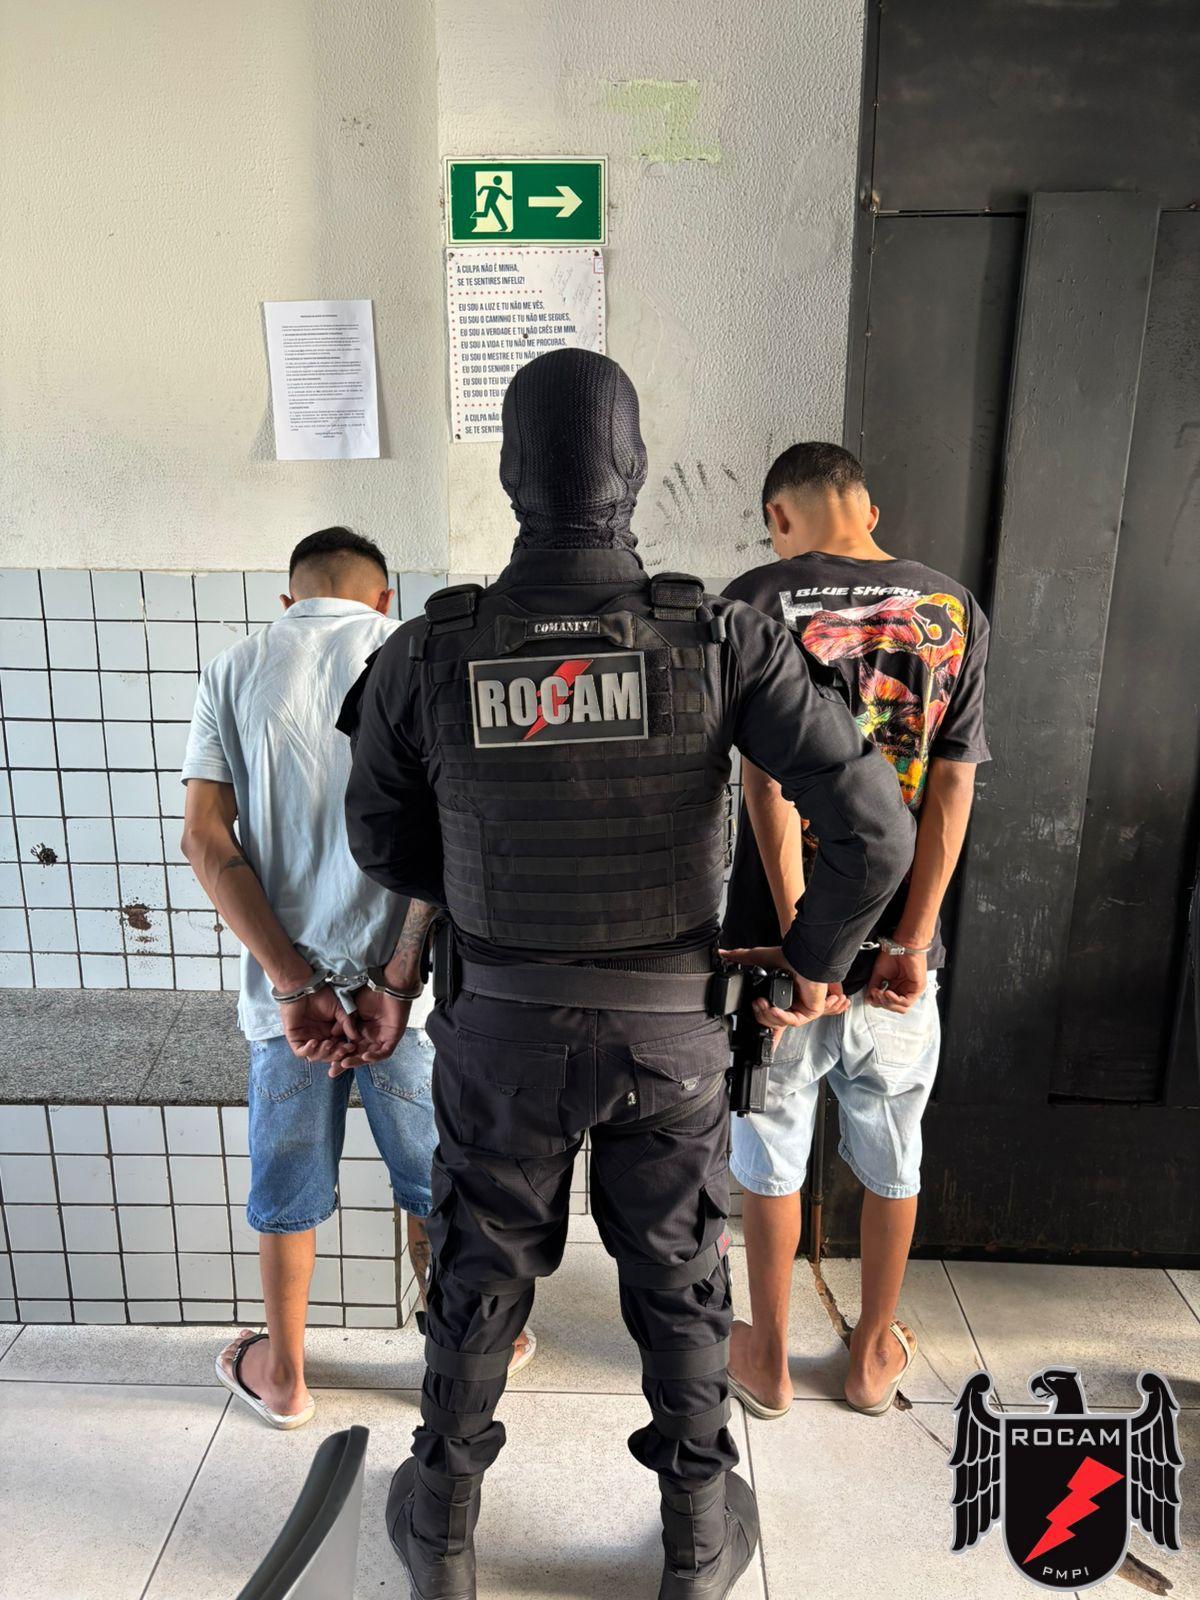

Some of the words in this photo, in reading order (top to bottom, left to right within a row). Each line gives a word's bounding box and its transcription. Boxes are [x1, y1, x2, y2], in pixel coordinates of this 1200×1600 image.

[462, 265, 480, 273] CULPA
[481, 262, 493, 272] NÃO
[457, 278, 464, 286] SE
[466, 278, 473, 286] TE
[474, 277, 501, 285] SENTIRES
[459, 303, 466, 311] EU
[467, 303, 479, 311] SOU
[485, 302, 496, 310] LUZ
[501, 302, 509, 310] TU
[510, 300, 522, 310] NÃO
[523, 301, 531, 309] ME
[459, 316, 467, 324] EU
[468, 315, 480, 324] SOU
[485, 314, 511, 323] CAMINHO
[517, 314, 525, 322] TU
[526, 312, 538, 322] NÃO
[539, 313, 547, 321] ME
[460, 328, 468, 336] EU
[469, 328, 480, 336] SOU
[486, 327, 511, 335] VERDADE
[517, 326, 525, 334] TU
[526, 325, 538, 334] NÃO
[539, 324, 553, 334] CRÊS
[554, 325, 562, 334] EM
[461, 341, 468, 349] EU
[469, 341, 481, 349] SOU
[486, 340, 500, 348] VIDA
[505, 339, 513, 347] TU
[514, 338, 526, 347] NÃO
[527, 338, 535, 346] ME
[461, 353, 469, 361] EU
[470, 353, 481, 361] SOU
[487, 352, 510, 360] MESTRE
[515, 351, 523, 360] TU
[524, 350, 536, 359] NÃO
[462, 365, 470, 373] EU
[471, 365, 482, 373] SOU
[488, 364, 510, 373] SENHOR
[463, 377, 470, 386] EU
[471, 377, 482, 385] SOU
[489, 377, 499, 385] TEU
[463, 389, 471, 398] EU
[472, 389, 483, 397] SOU
[489, 389, 499, 397] TEU
[470, 413, 487, 421] CULPA
[488, 411, 500, 421] NÃO
[465, 426, 472, 434] SE
[474, 425, 480, 434] TE
[795, 587, 850, 597] BLUE
[852, 586, 921, 598] SHARK
[477, 671, 642, 728] ROCAM
